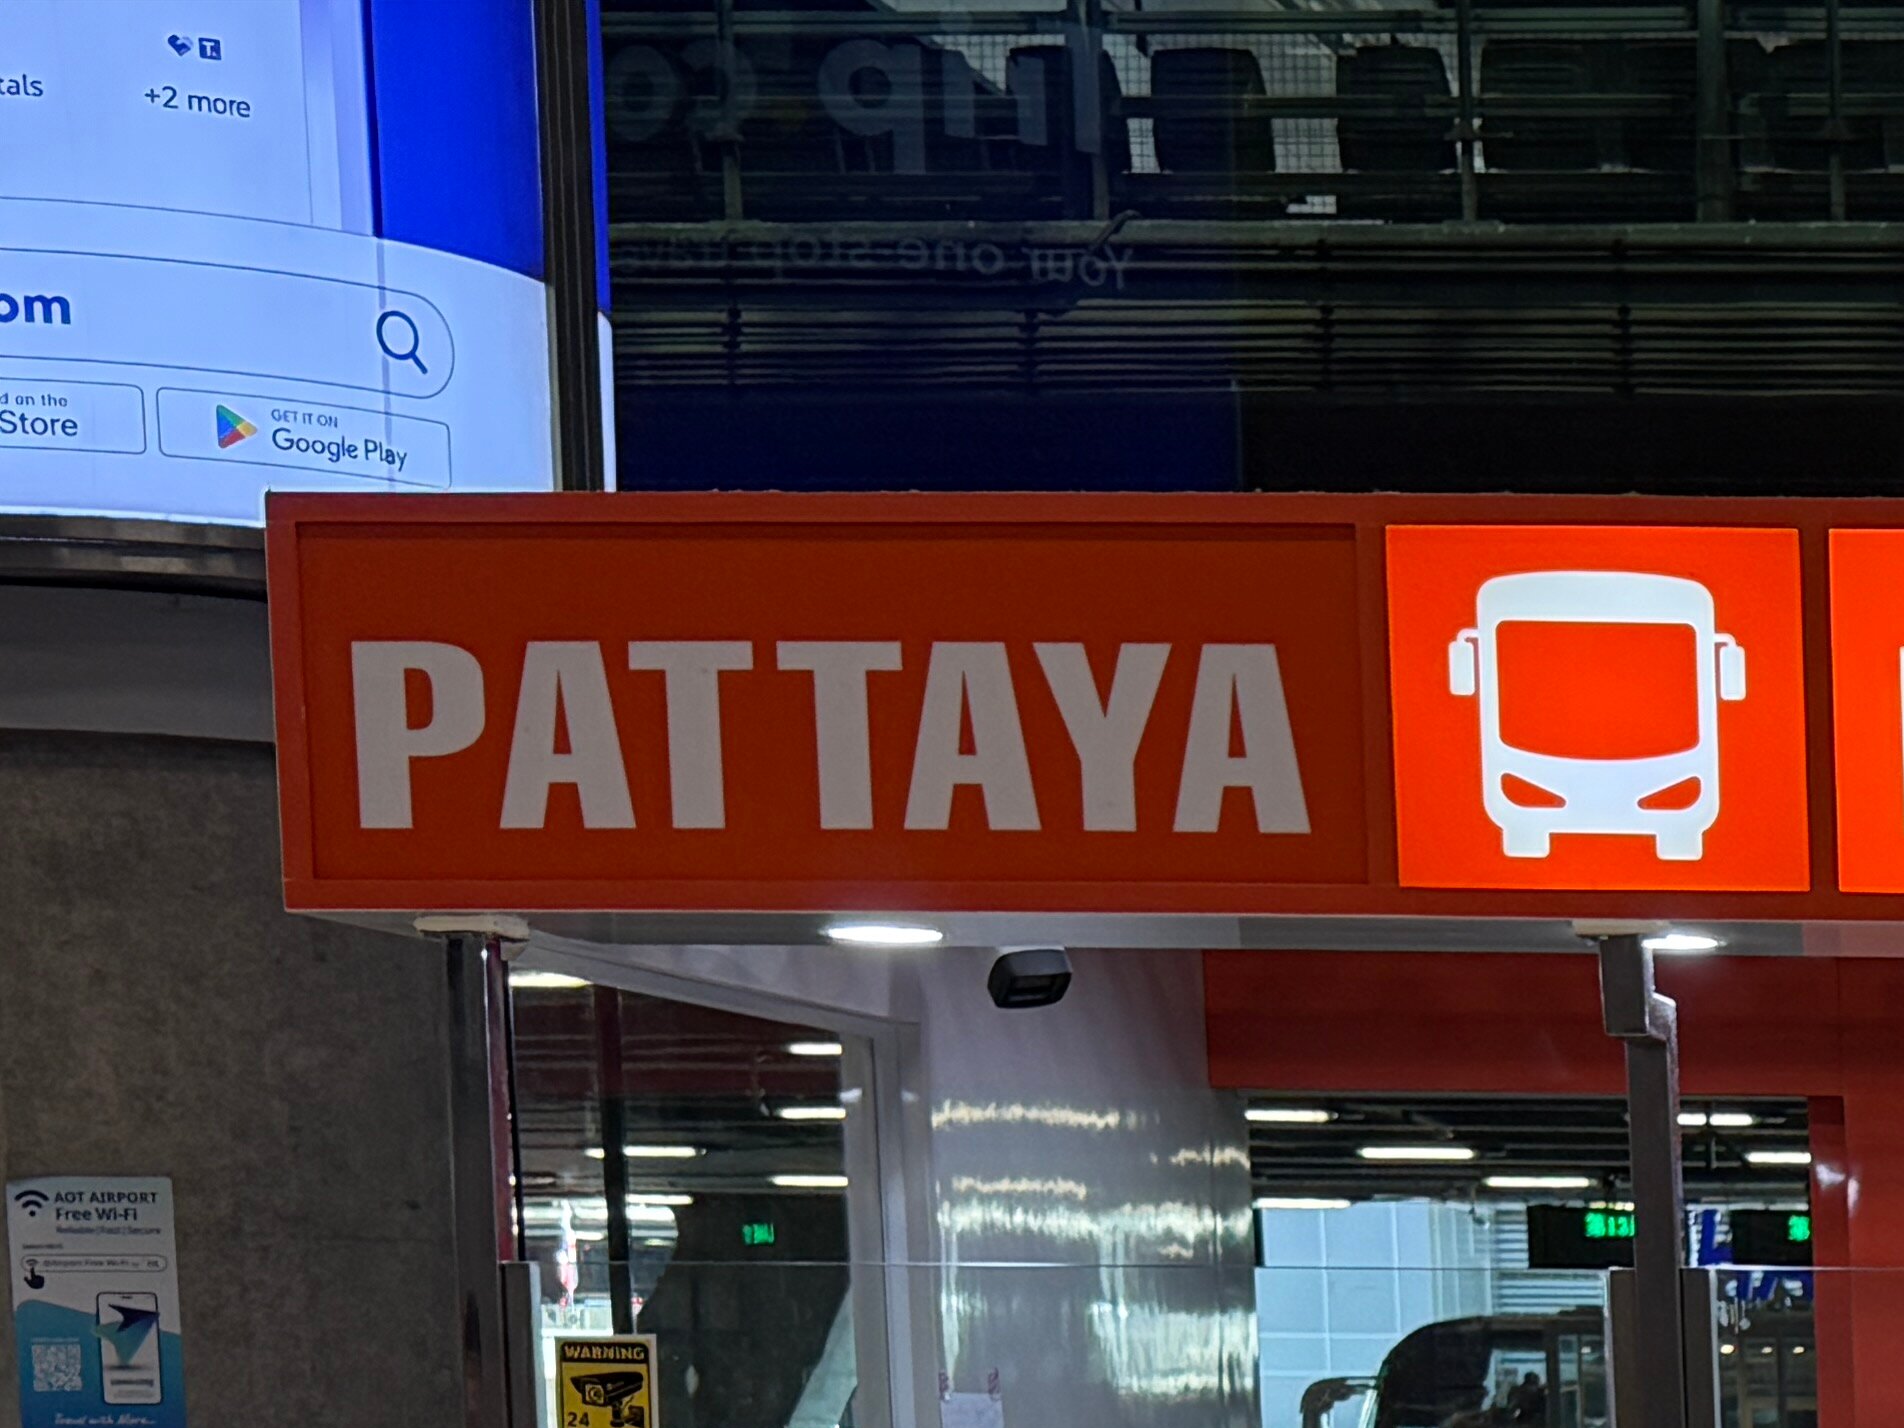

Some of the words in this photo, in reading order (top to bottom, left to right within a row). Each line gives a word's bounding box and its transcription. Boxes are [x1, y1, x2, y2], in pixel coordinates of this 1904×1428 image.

[145, 86, 178, 109] +2
[188, 93, 251, 118] more
[0, 409, 78, 437] Store
[271, 408, 299, 423] GET
[303, 411, 314, 424] IT
[318, 413, 338, 428] ON
[271, 428, 358, 463] Google
[364, 438, 408, 472] Play
[350, 638, 1313, 835] PATTAYA
[54, 1191, 85, 1203] AOT
[90, 1191, 159, 1204] AIRPORT
[55, 1207, 91, 1221] Free
[95, 1207, 138, 1221] Wi-Fi
[564, 1345, 645, 1360] WARNING
[567, 1411, 590, 1428] 24
